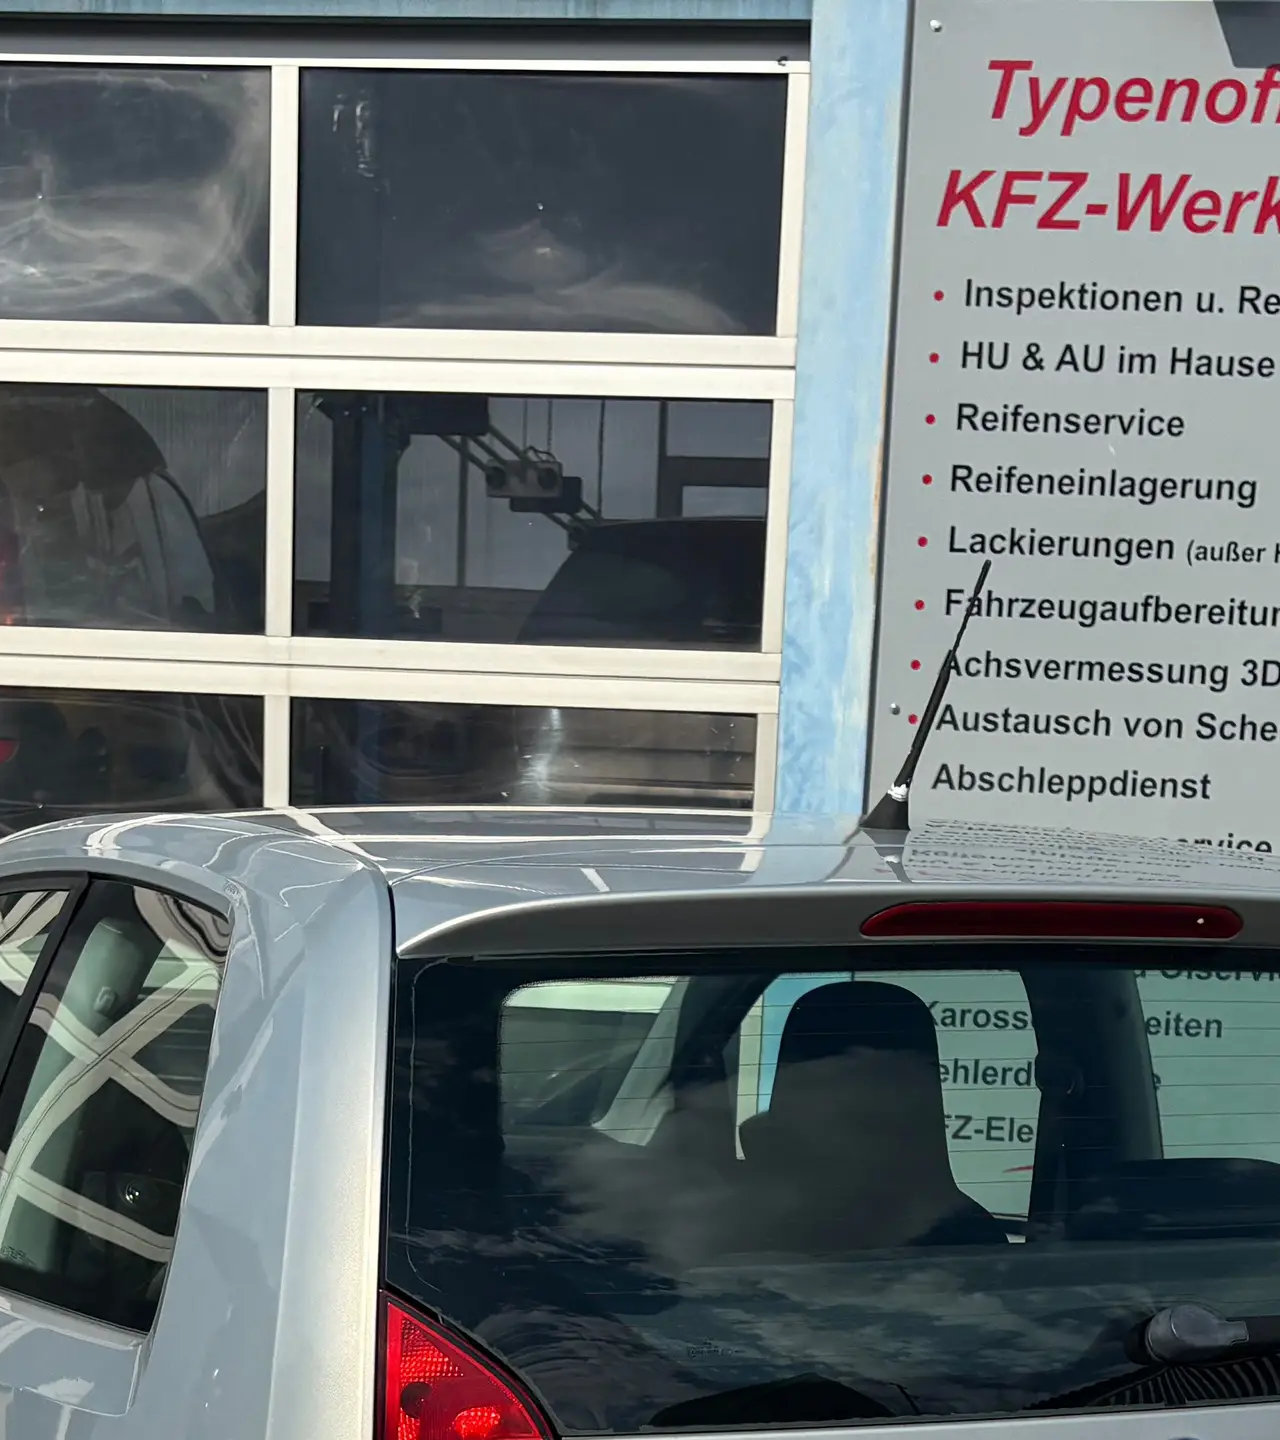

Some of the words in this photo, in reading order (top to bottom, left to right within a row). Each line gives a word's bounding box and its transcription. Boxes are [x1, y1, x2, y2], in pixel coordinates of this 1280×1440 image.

[965, 279, 1183, 316] Inspektionen
[1196, 291, 1224, 314] u.
[961, 341, 1010, 371] HU
[1022, 343, 1045, 372] &
[1055, 344, 1106, 373] AU
[1118, 345, 1157, 375] im
[1170, 347, 1276, 378] Hause
[956, 403, 1185, 438] Reifenservice
[950, 464, 1258, 509] Reifeneinlagerung
[949, 525, 1175, 566] Lackierungen
[1186, 539, 1266, 568] (außer
[946, 649, 1229, 693] Achsvermessung
[935, 703, 1112, 737] Austausch
[1123, 715, 1183, 740] von
[931, 762, 1212, 803] Abschleppdienst
